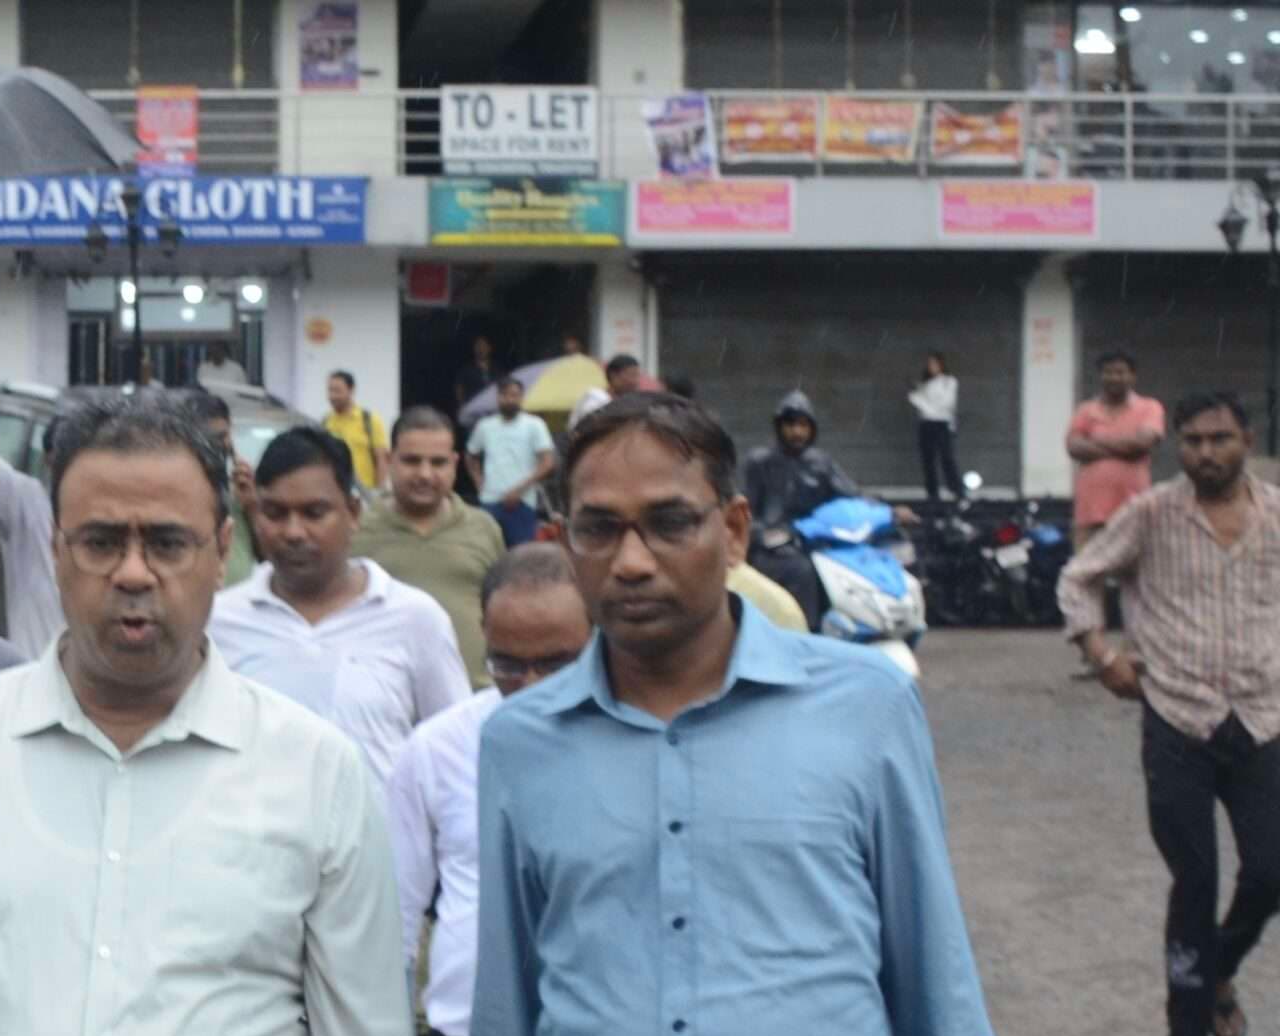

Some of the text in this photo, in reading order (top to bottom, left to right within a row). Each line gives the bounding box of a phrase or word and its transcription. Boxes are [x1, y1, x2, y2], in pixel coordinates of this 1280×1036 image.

[451, 92, 494, 130] TO
[528, 92, 589, 130] LET
[450, 138, 591, 151] SPACE FOR RENT
[144, 178, 315, 221] CLOTH
